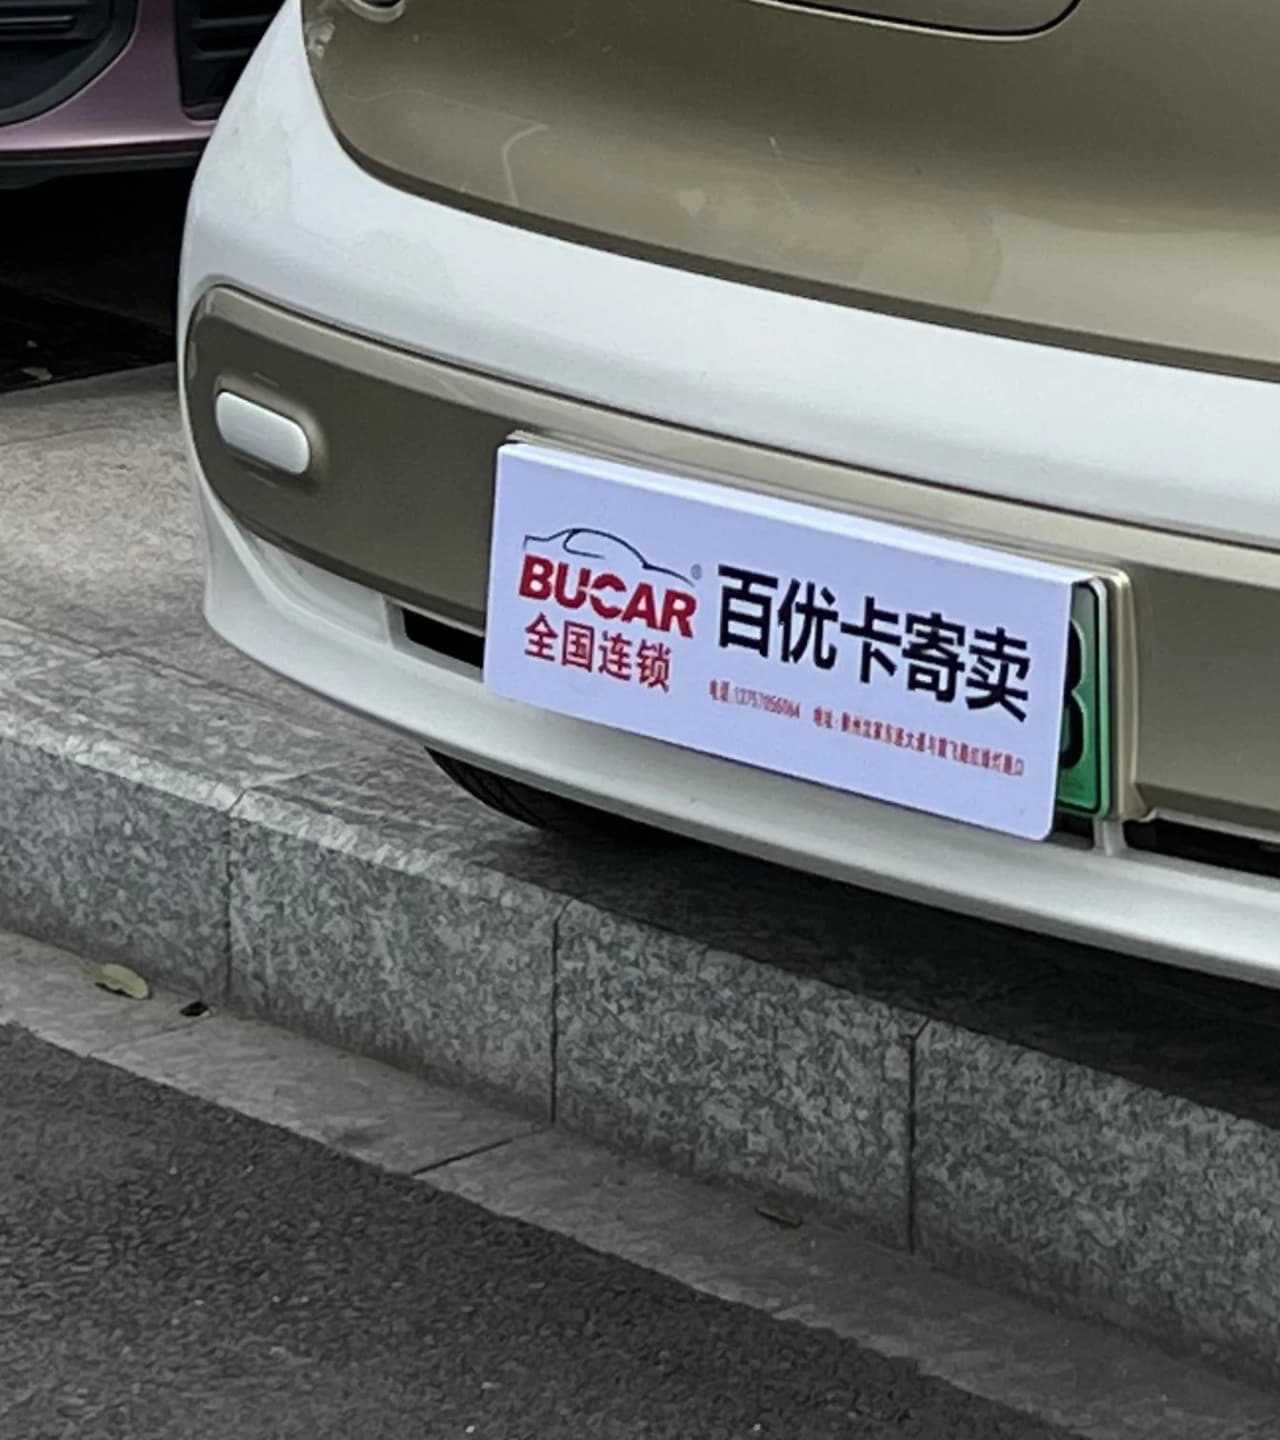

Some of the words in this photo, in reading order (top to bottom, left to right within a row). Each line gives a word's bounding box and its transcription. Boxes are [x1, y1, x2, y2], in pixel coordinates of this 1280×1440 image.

[518, 553, 697, 640] BUCAR
[524, 612, 671, 693] 全国连锁
[717, 563, 1031, 723] 百优卡寄卖
